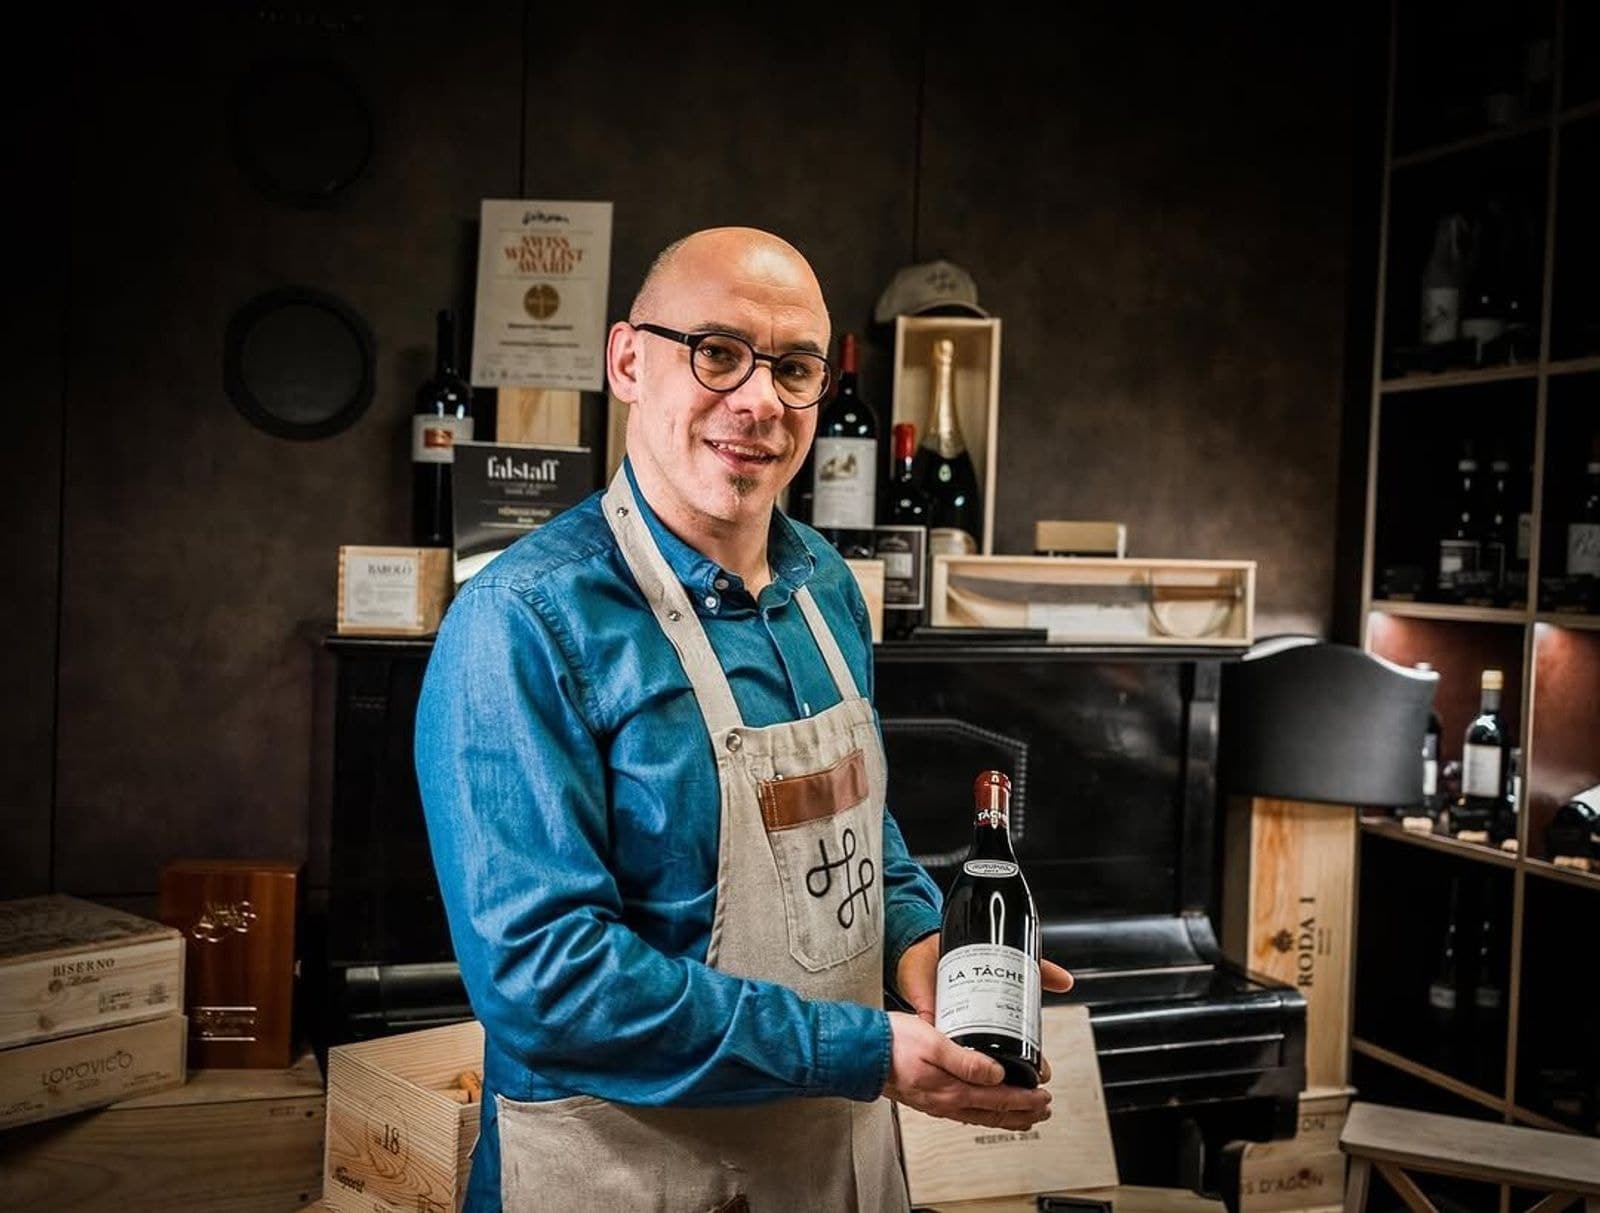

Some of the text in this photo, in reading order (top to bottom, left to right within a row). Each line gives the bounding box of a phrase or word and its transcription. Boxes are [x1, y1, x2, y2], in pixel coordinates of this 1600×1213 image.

[521, 235, 571, 249] SWISS
[504, 247, 584, 263] WINE LIST
[518, 261, 573, 274] AWARD
[487, 455, 561, 482] falstaff
[1297, 917, 1316, 987] RODA
[52, 957, 117, 978] BISERNO
[948, 970, 967, 984] LA
[972, 964, 1026, 985] TÂCHE
[41, 1051, 134, 1087] LODOVICO
